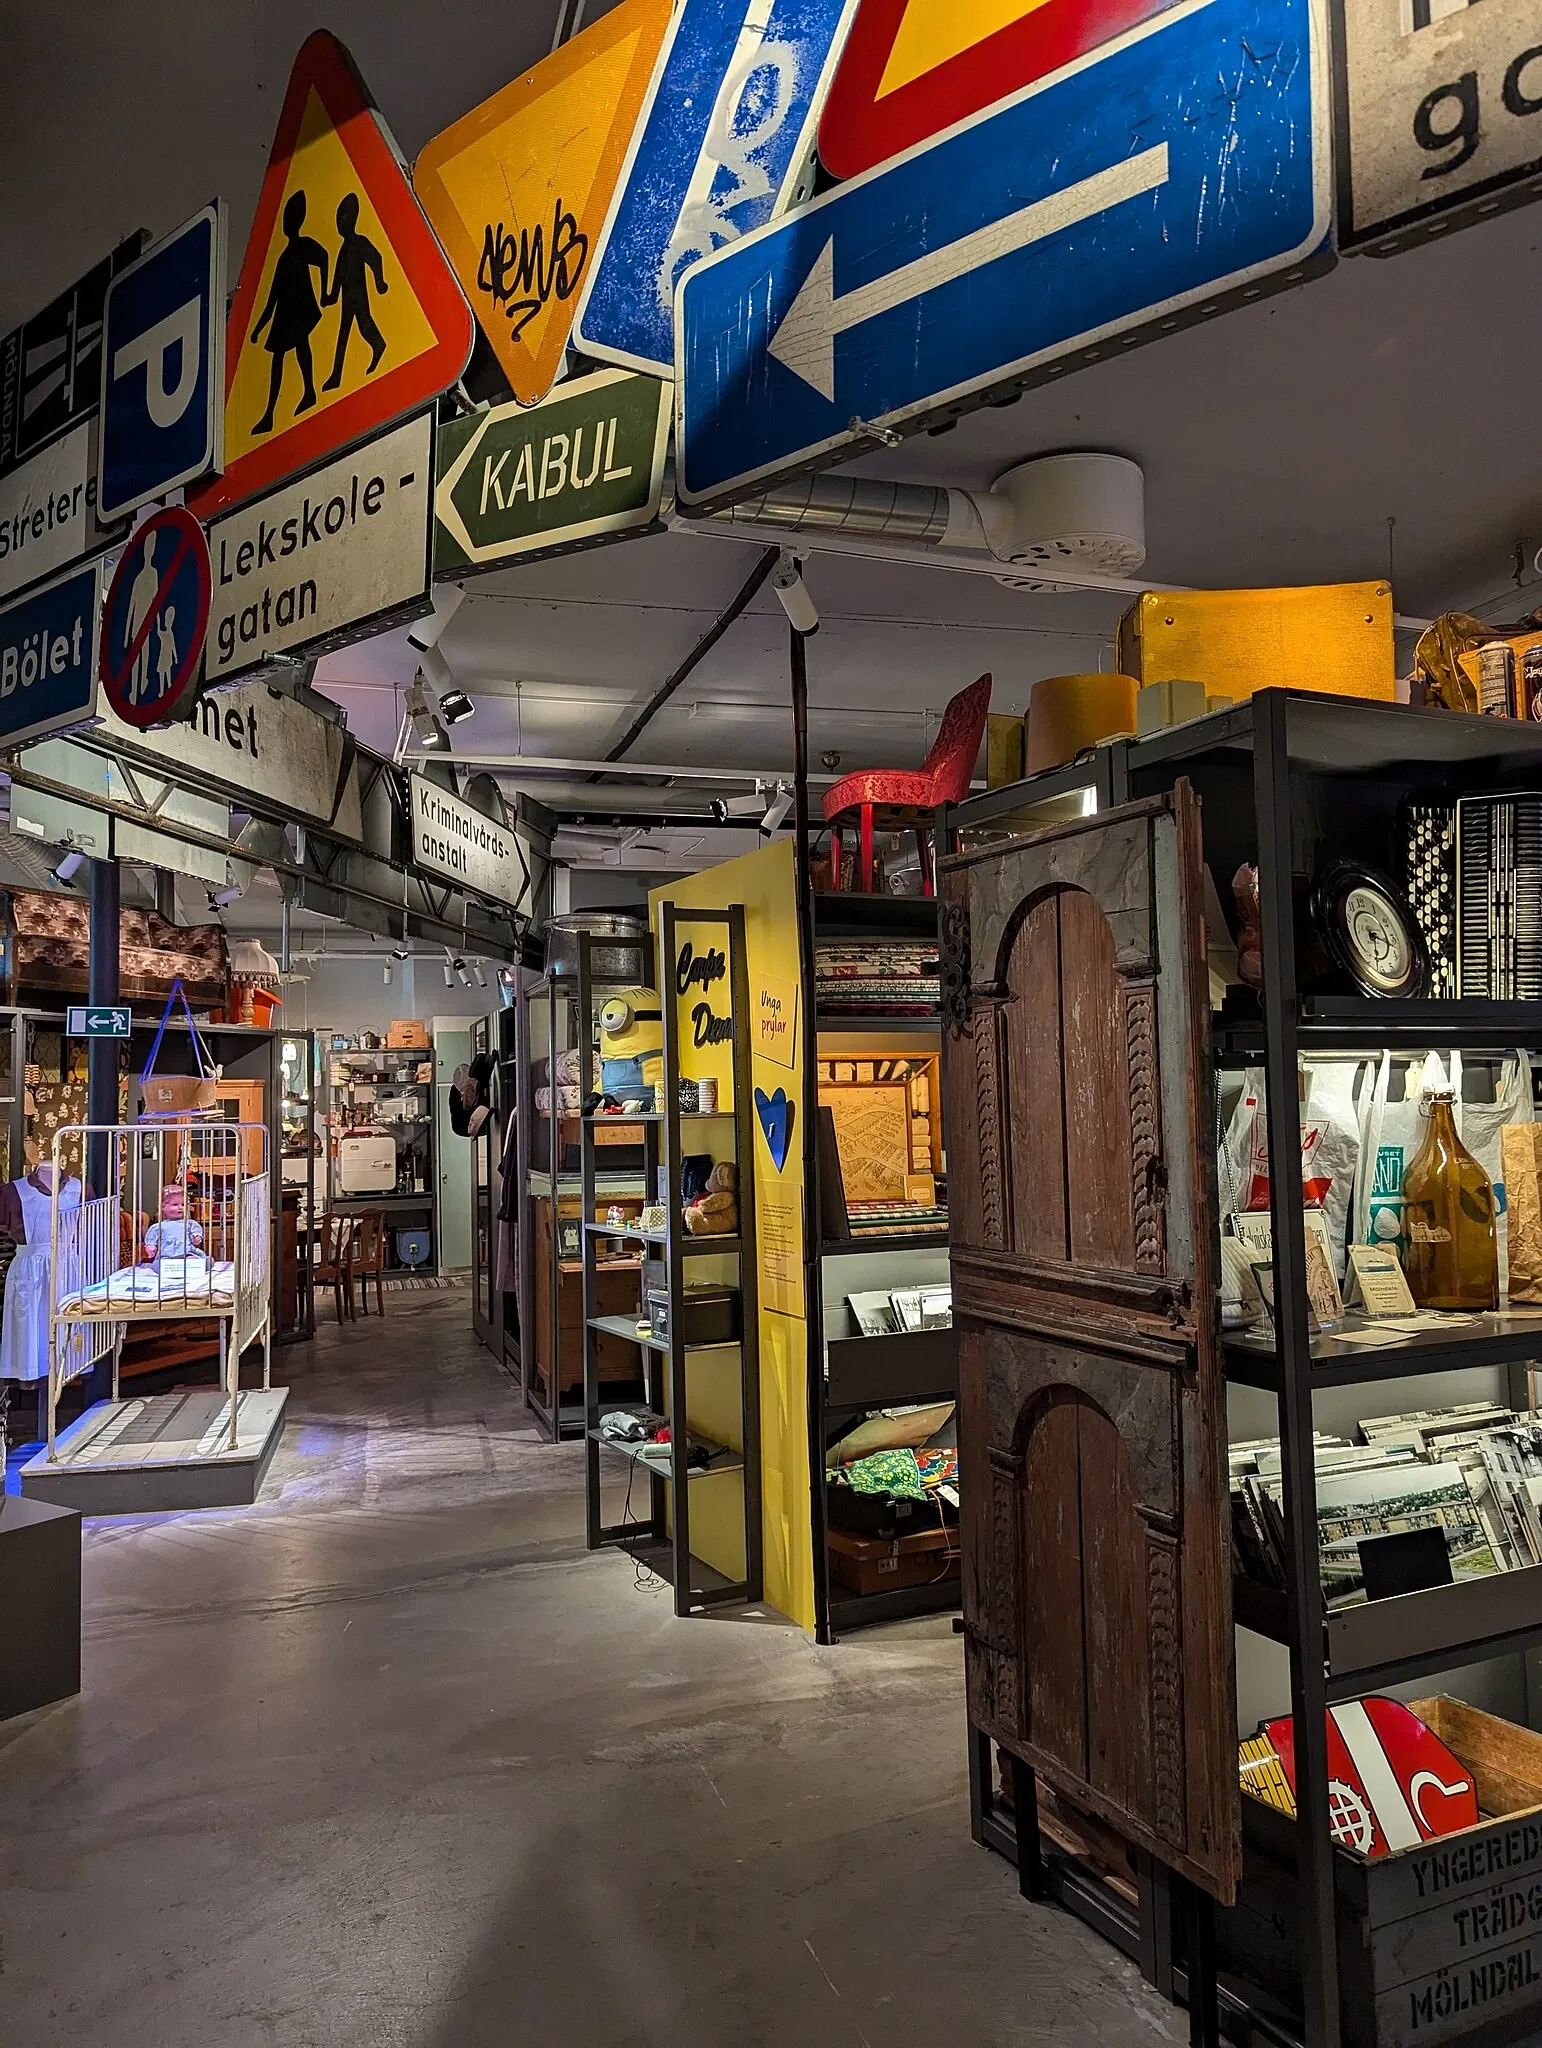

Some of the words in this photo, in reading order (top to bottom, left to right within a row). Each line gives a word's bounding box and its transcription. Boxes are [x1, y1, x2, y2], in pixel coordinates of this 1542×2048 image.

[479, 415, 634, 517] KABUL
[217, 575, 319, 664] gatan
[2, 615, 84, 698] Bölet
[420, 787, 510, 859] Kriminalvårds-
[422, 833, 467, 874] anstalt
[676, 941, 727, 996] Carpe
[760, 990, 783, 1017] Unga
[760, 1015, 788, 1041] prylar
[1409, 1949, 1541, 2030] MÖLNDAL
